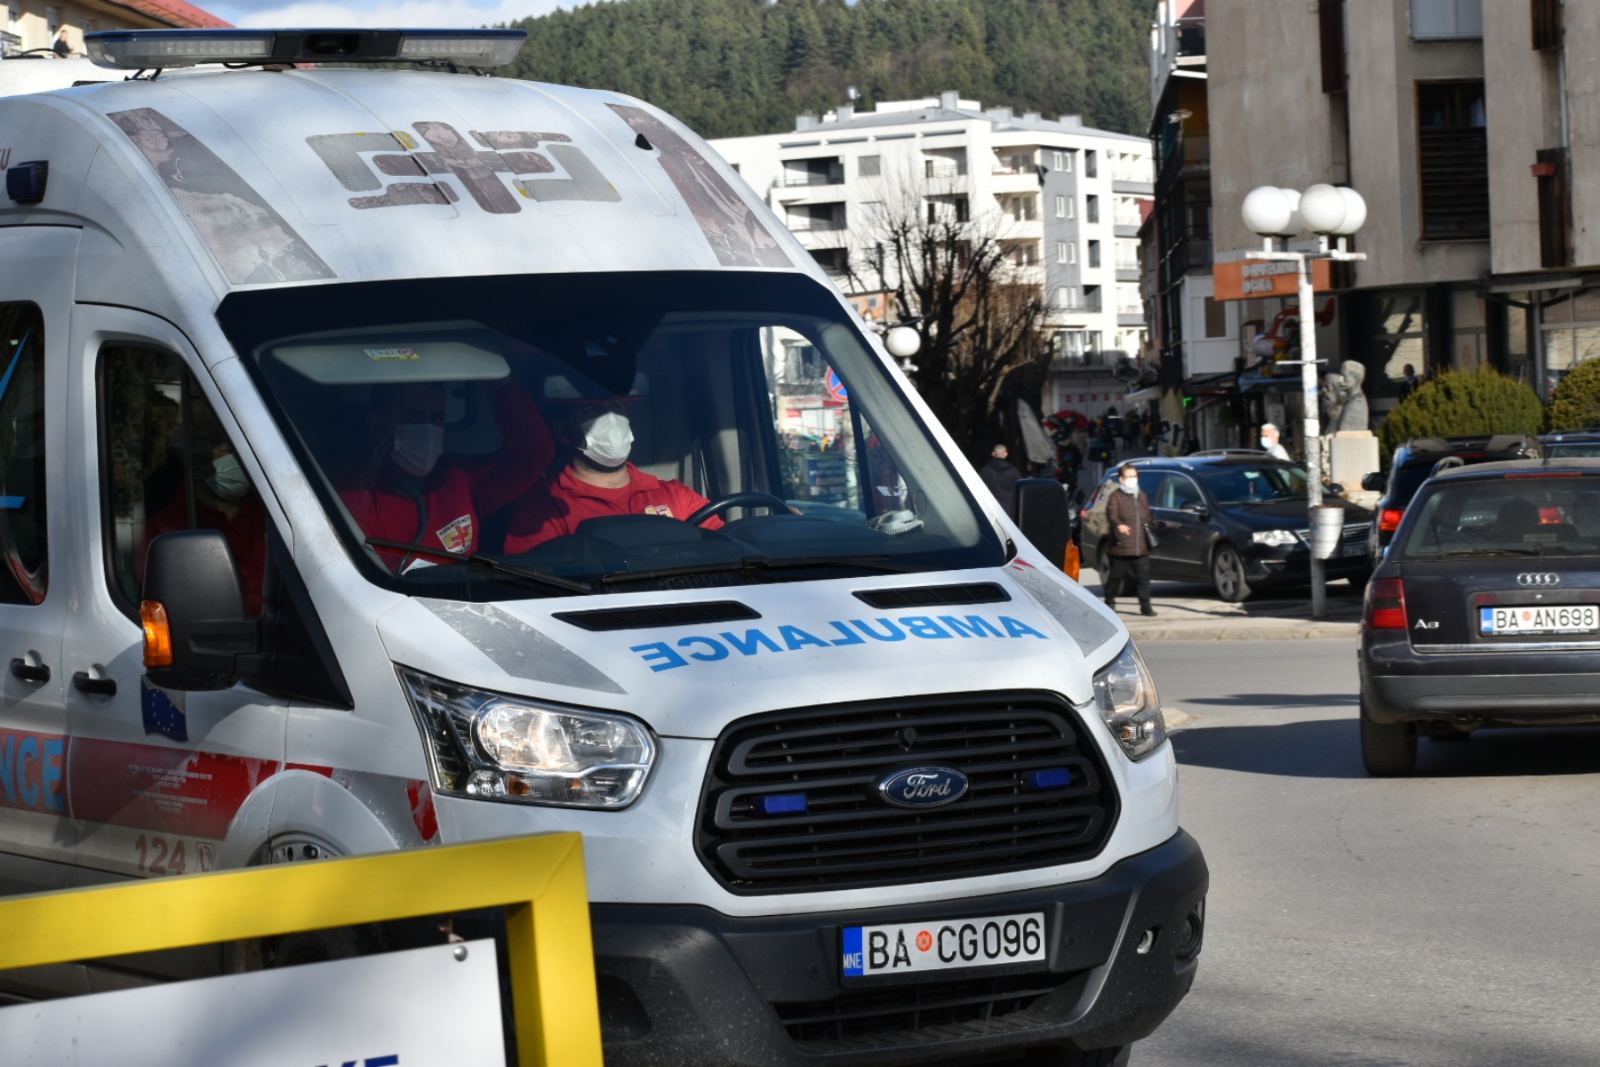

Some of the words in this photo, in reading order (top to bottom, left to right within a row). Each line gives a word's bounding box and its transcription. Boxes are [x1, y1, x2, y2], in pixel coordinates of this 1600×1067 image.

[1496, 609, 1519, 628] BA
[1534, 608, 1594, 627] AN698
[903, 773, 952, 799] Ford
[135, 834, 186, 875] 124
[869, 928, 911, 969] BA
[937, 917, 1041, 963] CG096
[843, 952, 863, 969] MNE
